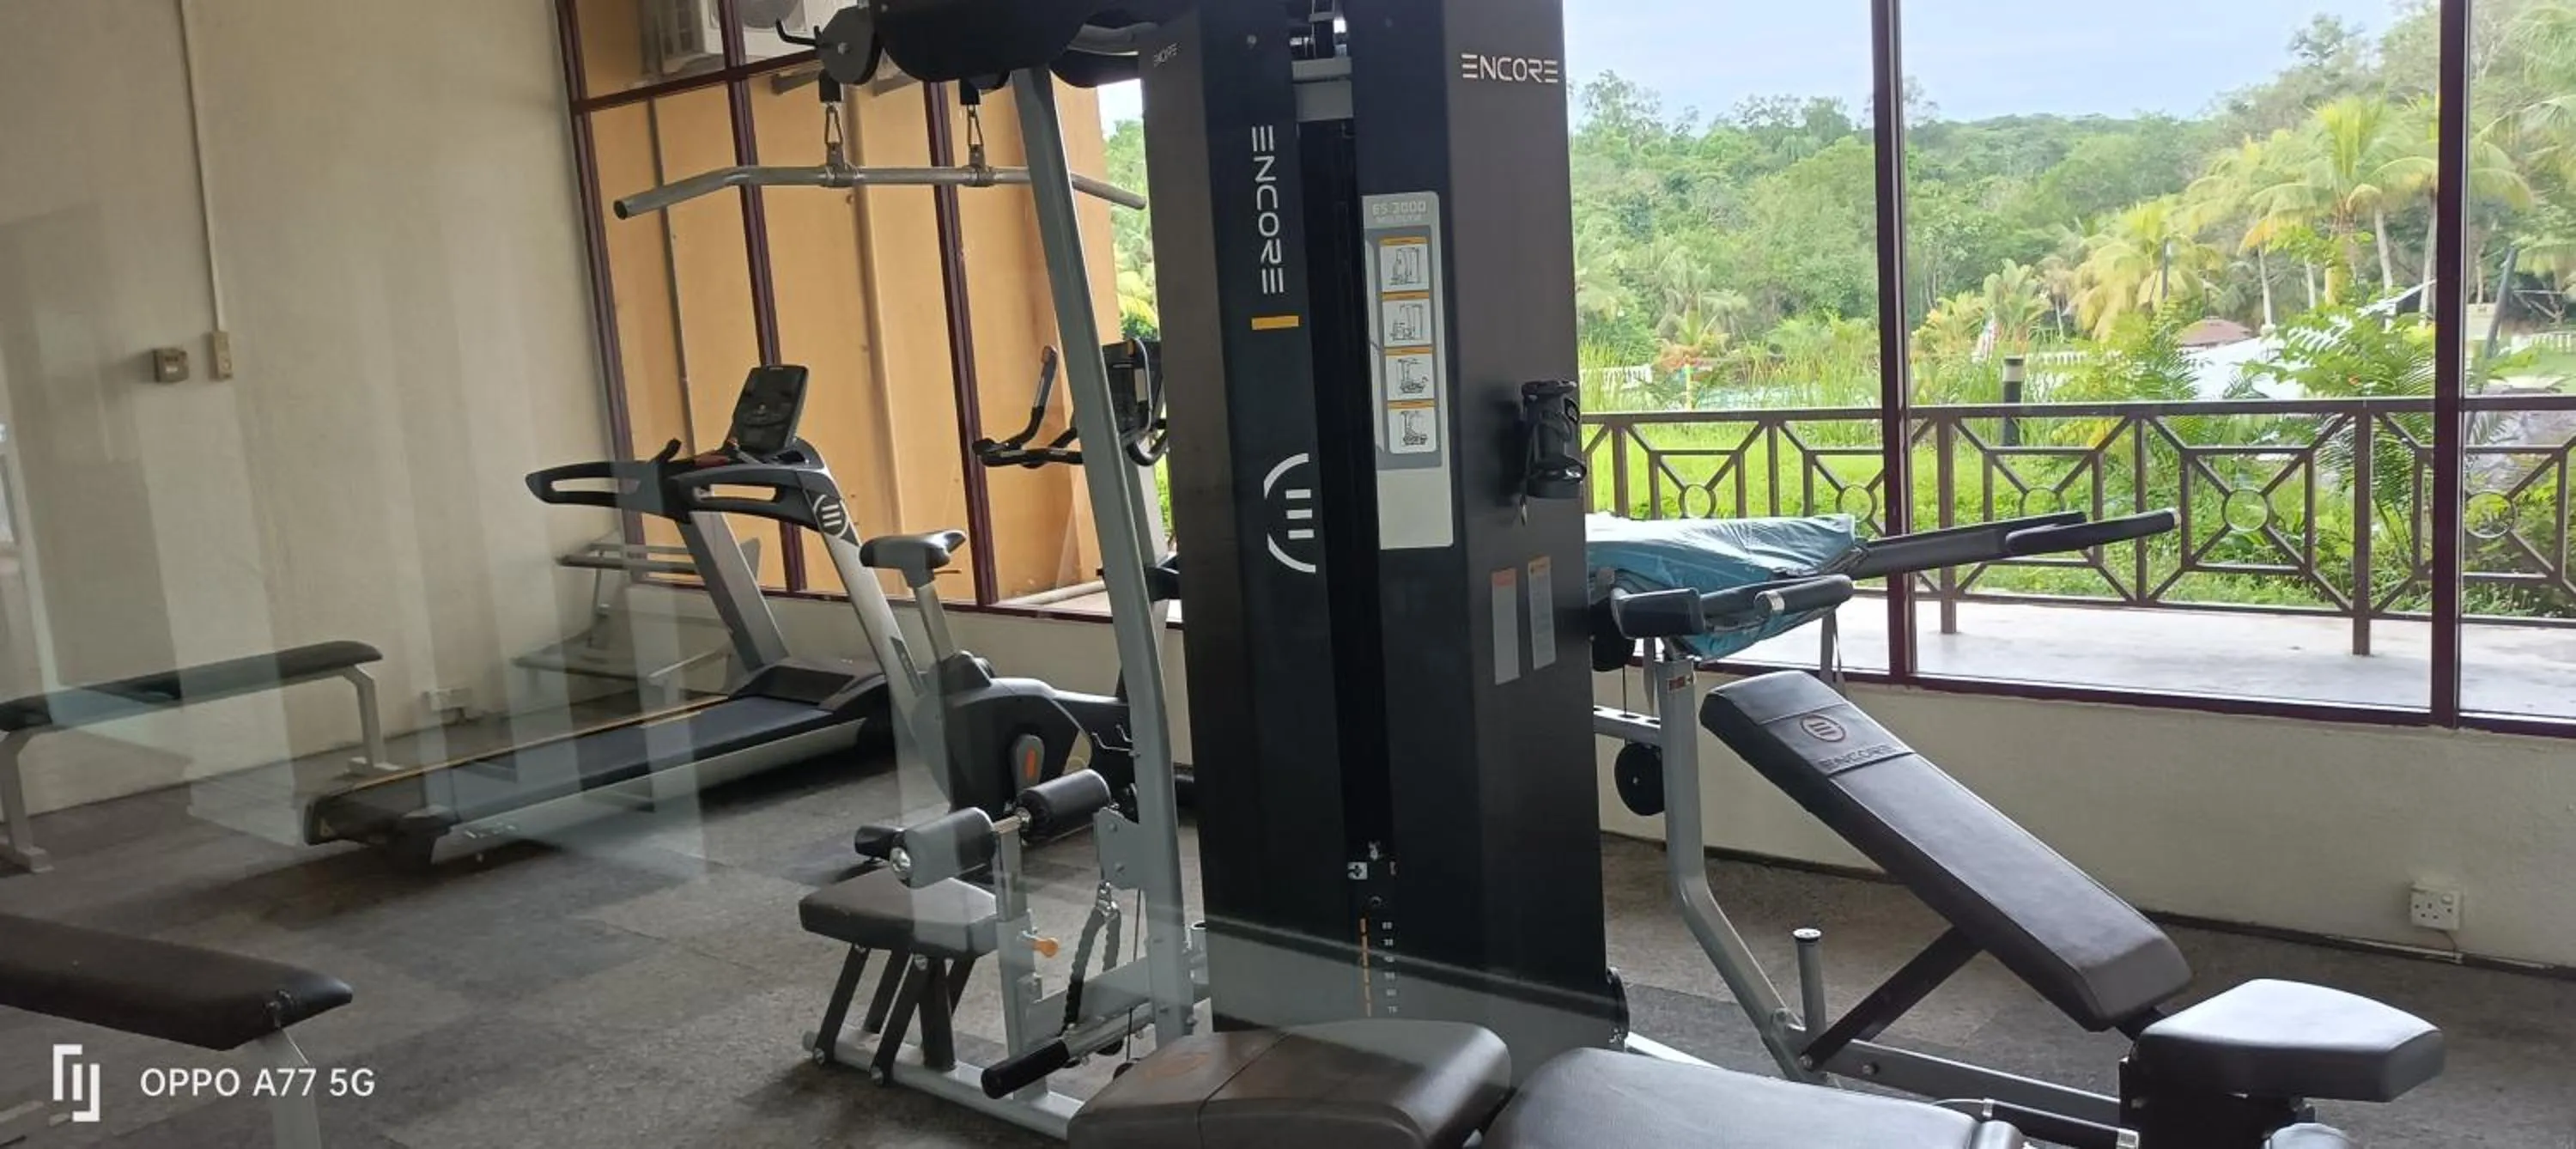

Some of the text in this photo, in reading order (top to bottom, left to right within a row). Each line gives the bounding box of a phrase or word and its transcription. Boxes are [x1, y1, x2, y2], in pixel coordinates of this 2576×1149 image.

[1461, 53, 1558, 83] ENCORE
[1251, 125, 1285, 295] ENCORE
[1818, 744, 1897, 770] ENCORE
